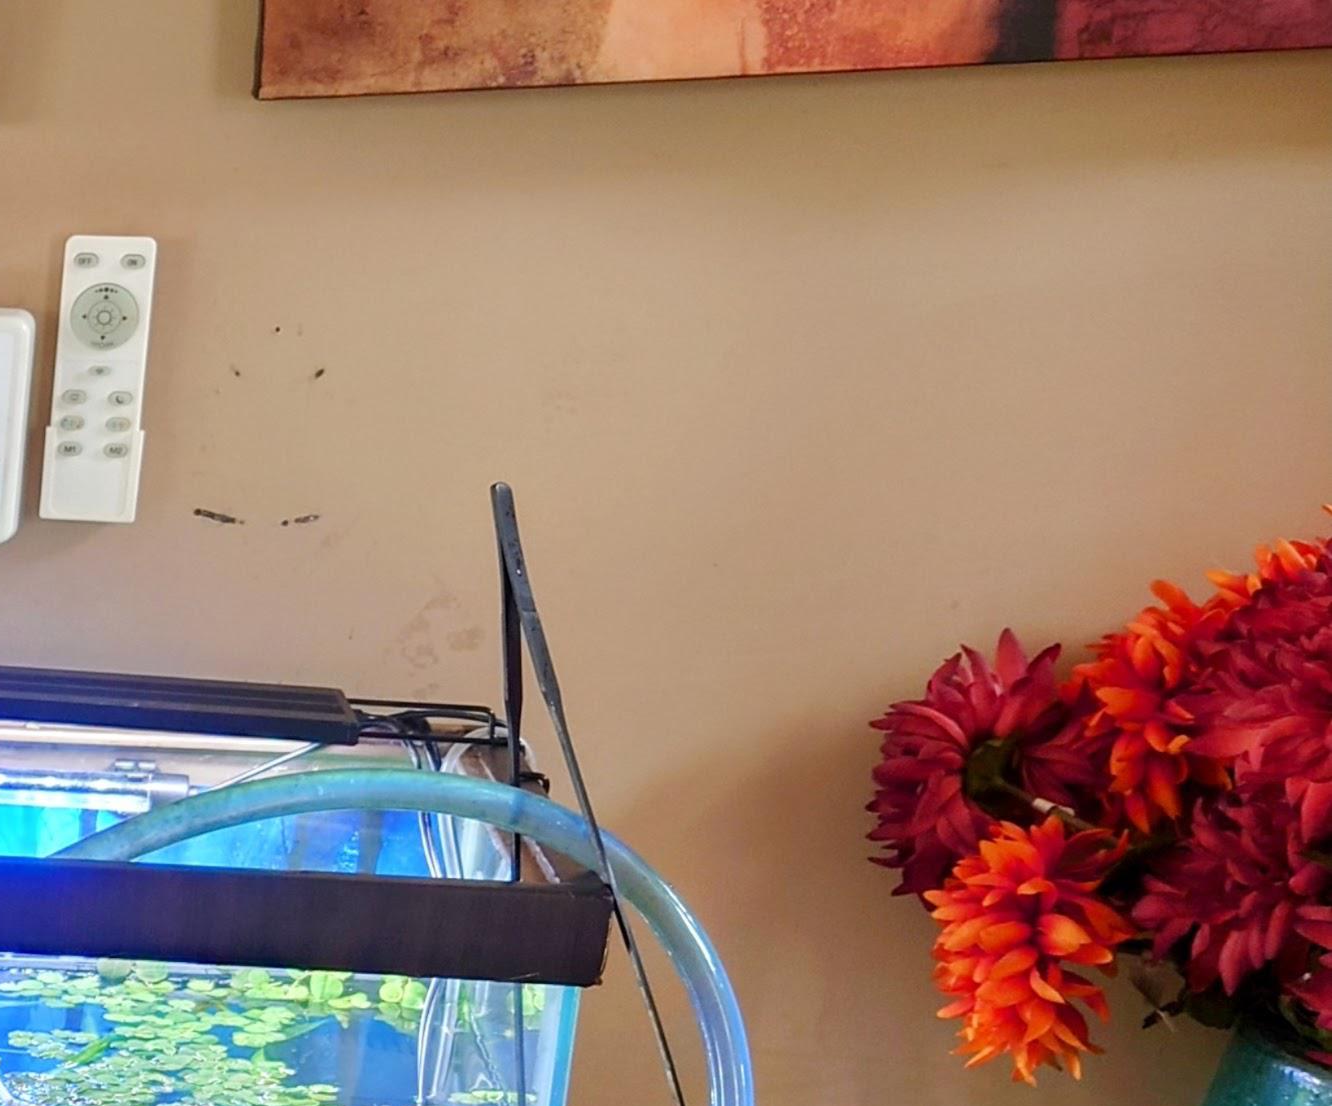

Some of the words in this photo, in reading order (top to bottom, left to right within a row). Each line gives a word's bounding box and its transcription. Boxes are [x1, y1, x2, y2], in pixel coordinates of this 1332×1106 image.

[126, 258, 138, 266] ON
[63, 445, 76, 453] M1
[109, 446, 123, 454] M2
